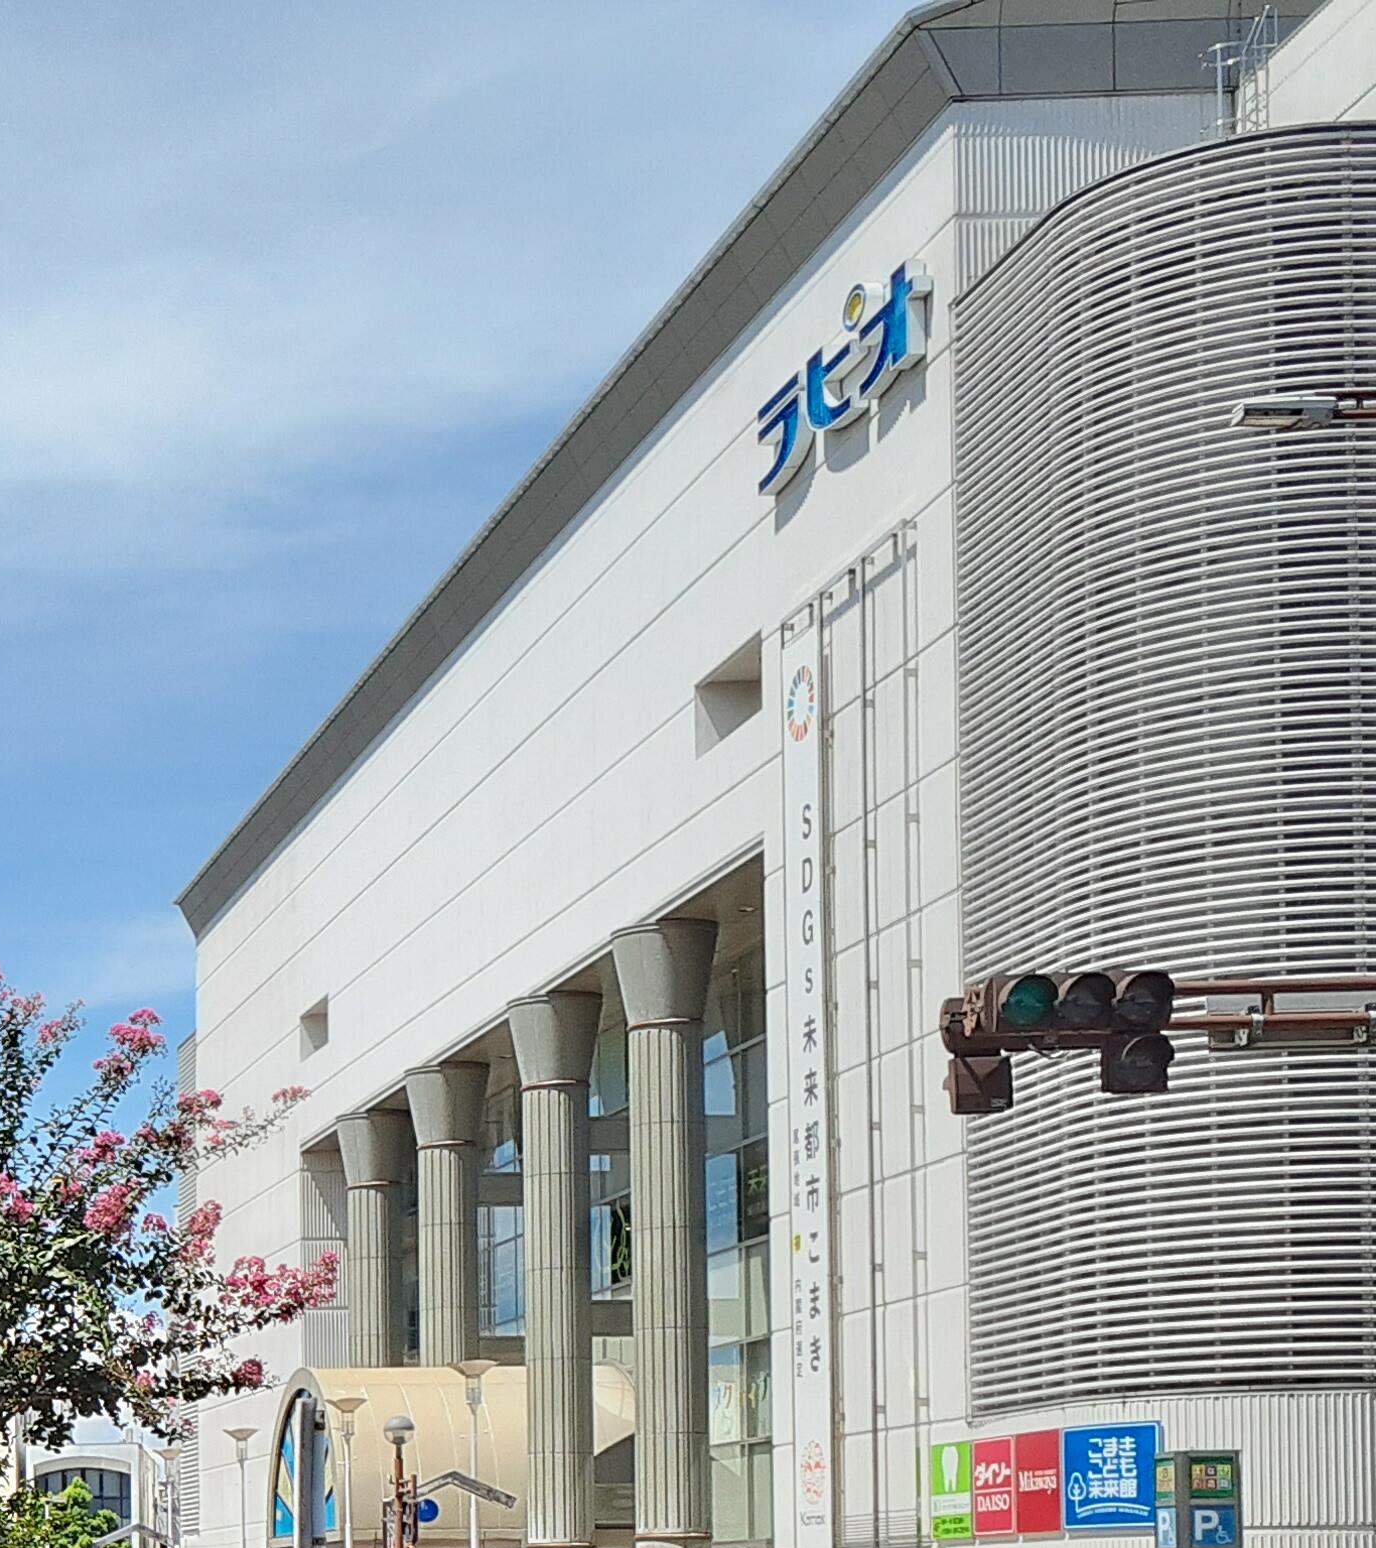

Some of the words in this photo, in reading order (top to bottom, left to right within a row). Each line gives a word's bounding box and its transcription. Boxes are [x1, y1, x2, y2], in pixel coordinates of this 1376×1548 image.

[757, 262, 932, 497] ラピオ
[800, 803, 823, 1374] SDGs未来都市こまき
[1088, 1436, 1136, 1458] こまき
[975, 1462, 1011, 1488] ダイソー
[1088, 1458, 1137, 1479] こども
[1088, 1479, 1137, 1500] 未来館
[977, 1494, 1010, 1513] DAISO
[1194, 1509, 1219, 1541] P
